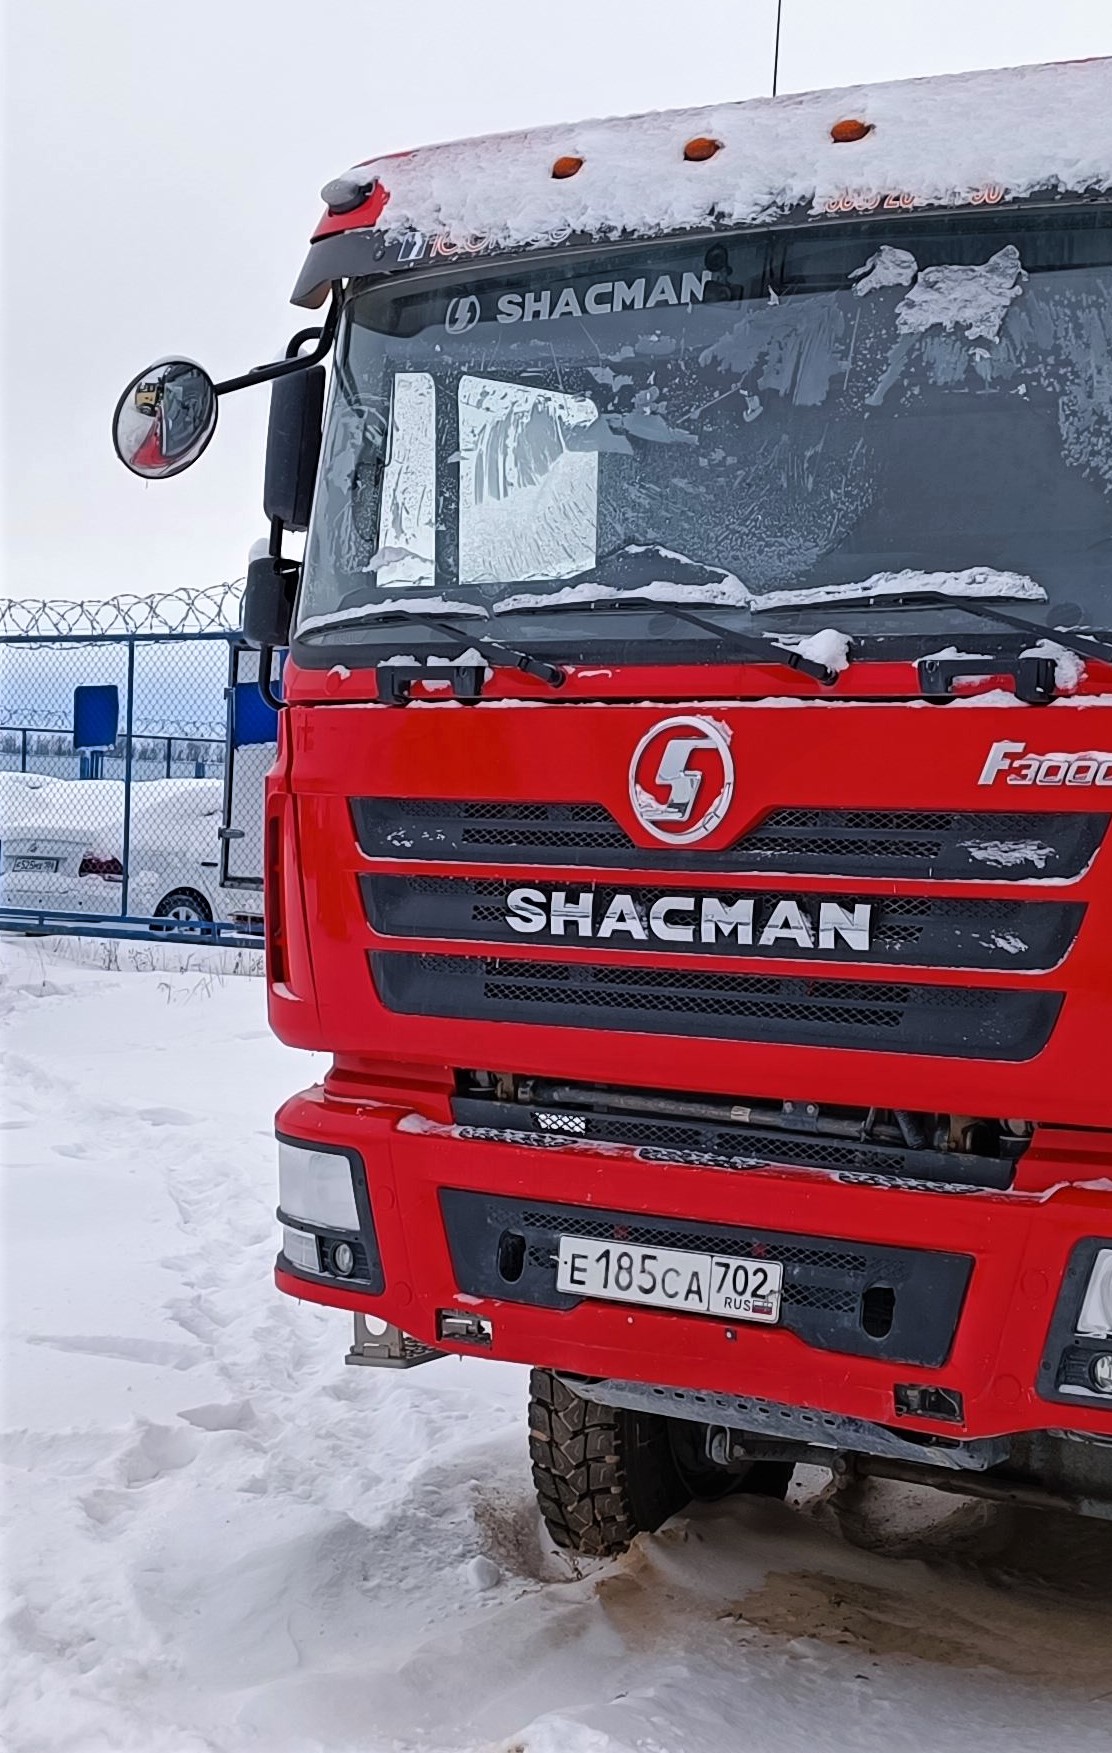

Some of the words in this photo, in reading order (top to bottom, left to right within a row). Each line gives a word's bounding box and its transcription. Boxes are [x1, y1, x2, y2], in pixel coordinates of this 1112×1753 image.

[497, 270, 712, 324] SHACMAN
[505, 888, 872, 952] SHACMAN
[569, 1248, 704, 1303] E185CA
[714, 1261, 769, 1299] 702
[723, 1296, 751, 1312] RUS
